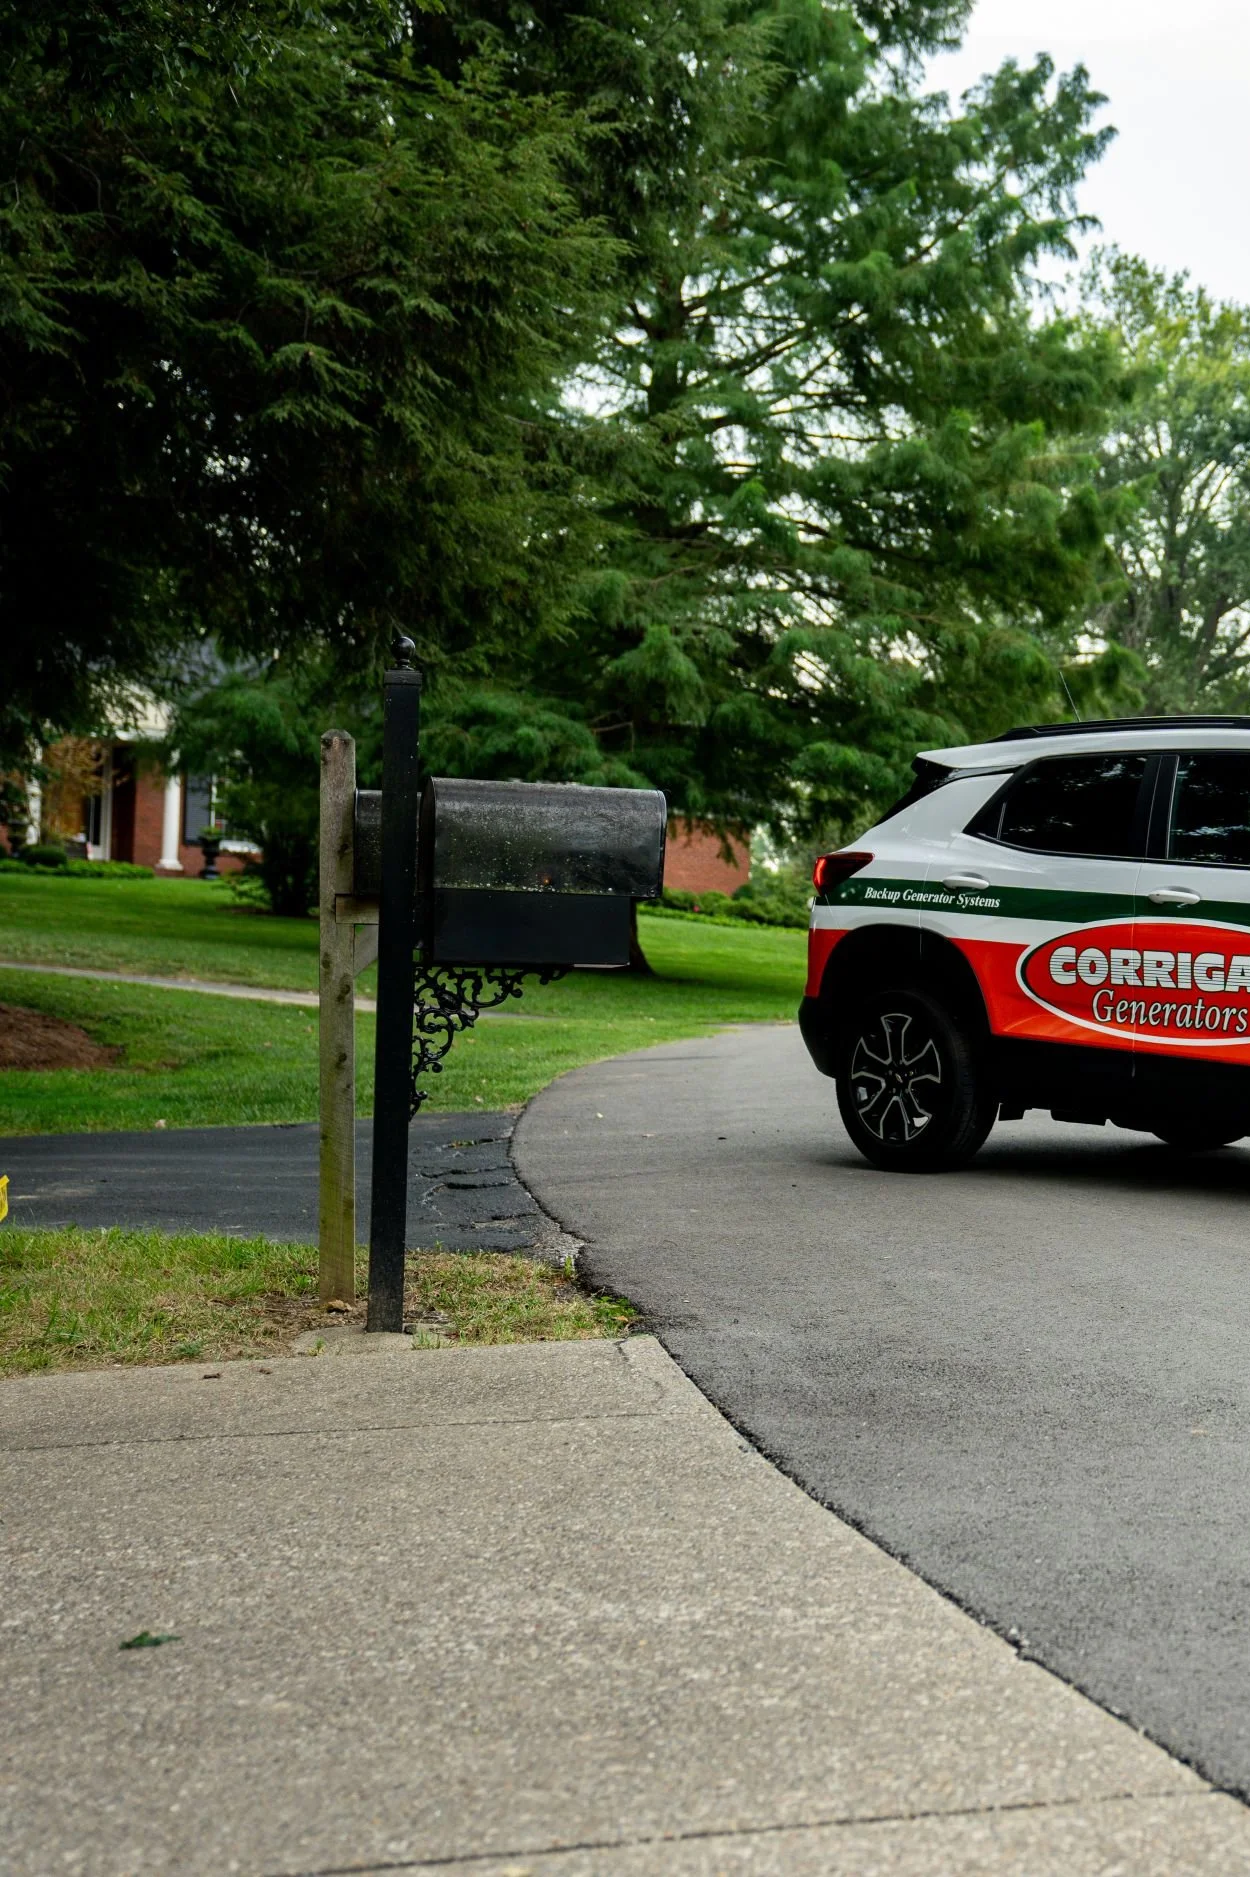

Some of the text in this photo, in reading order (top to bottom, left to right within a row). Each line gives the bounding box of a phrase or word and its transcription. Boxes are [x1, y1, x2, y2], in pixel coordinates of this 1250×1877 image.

[864, 886, 1001, 909] Backup Generator Systems
[1092, 989, 1249, 1032] Generators
